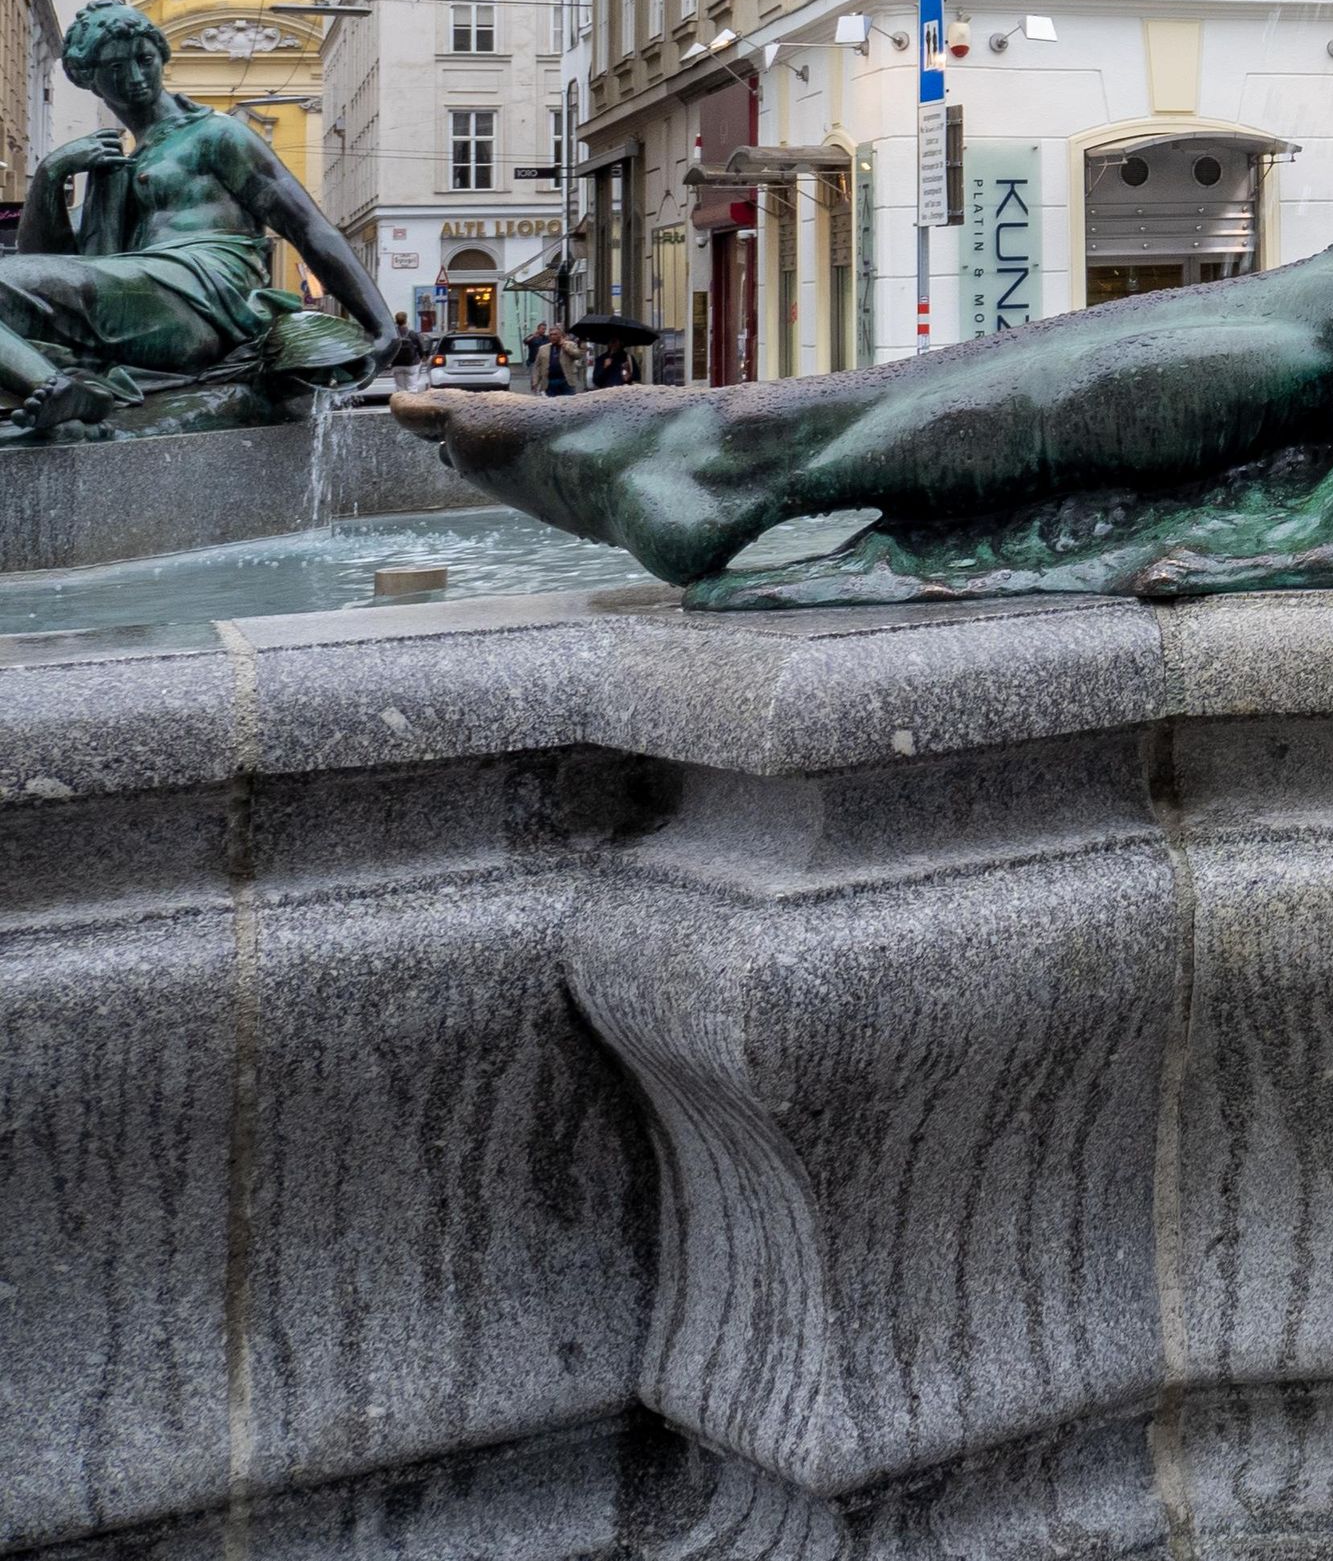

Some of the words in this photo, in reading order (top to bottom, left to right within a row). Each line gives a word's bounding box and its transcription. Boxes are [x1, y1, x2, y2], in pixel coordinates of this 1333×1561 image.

[973, 179, 984, 251] PLATIN
[441, 221, 486, 238] ALTE
[973, 268, 985, 278] &
